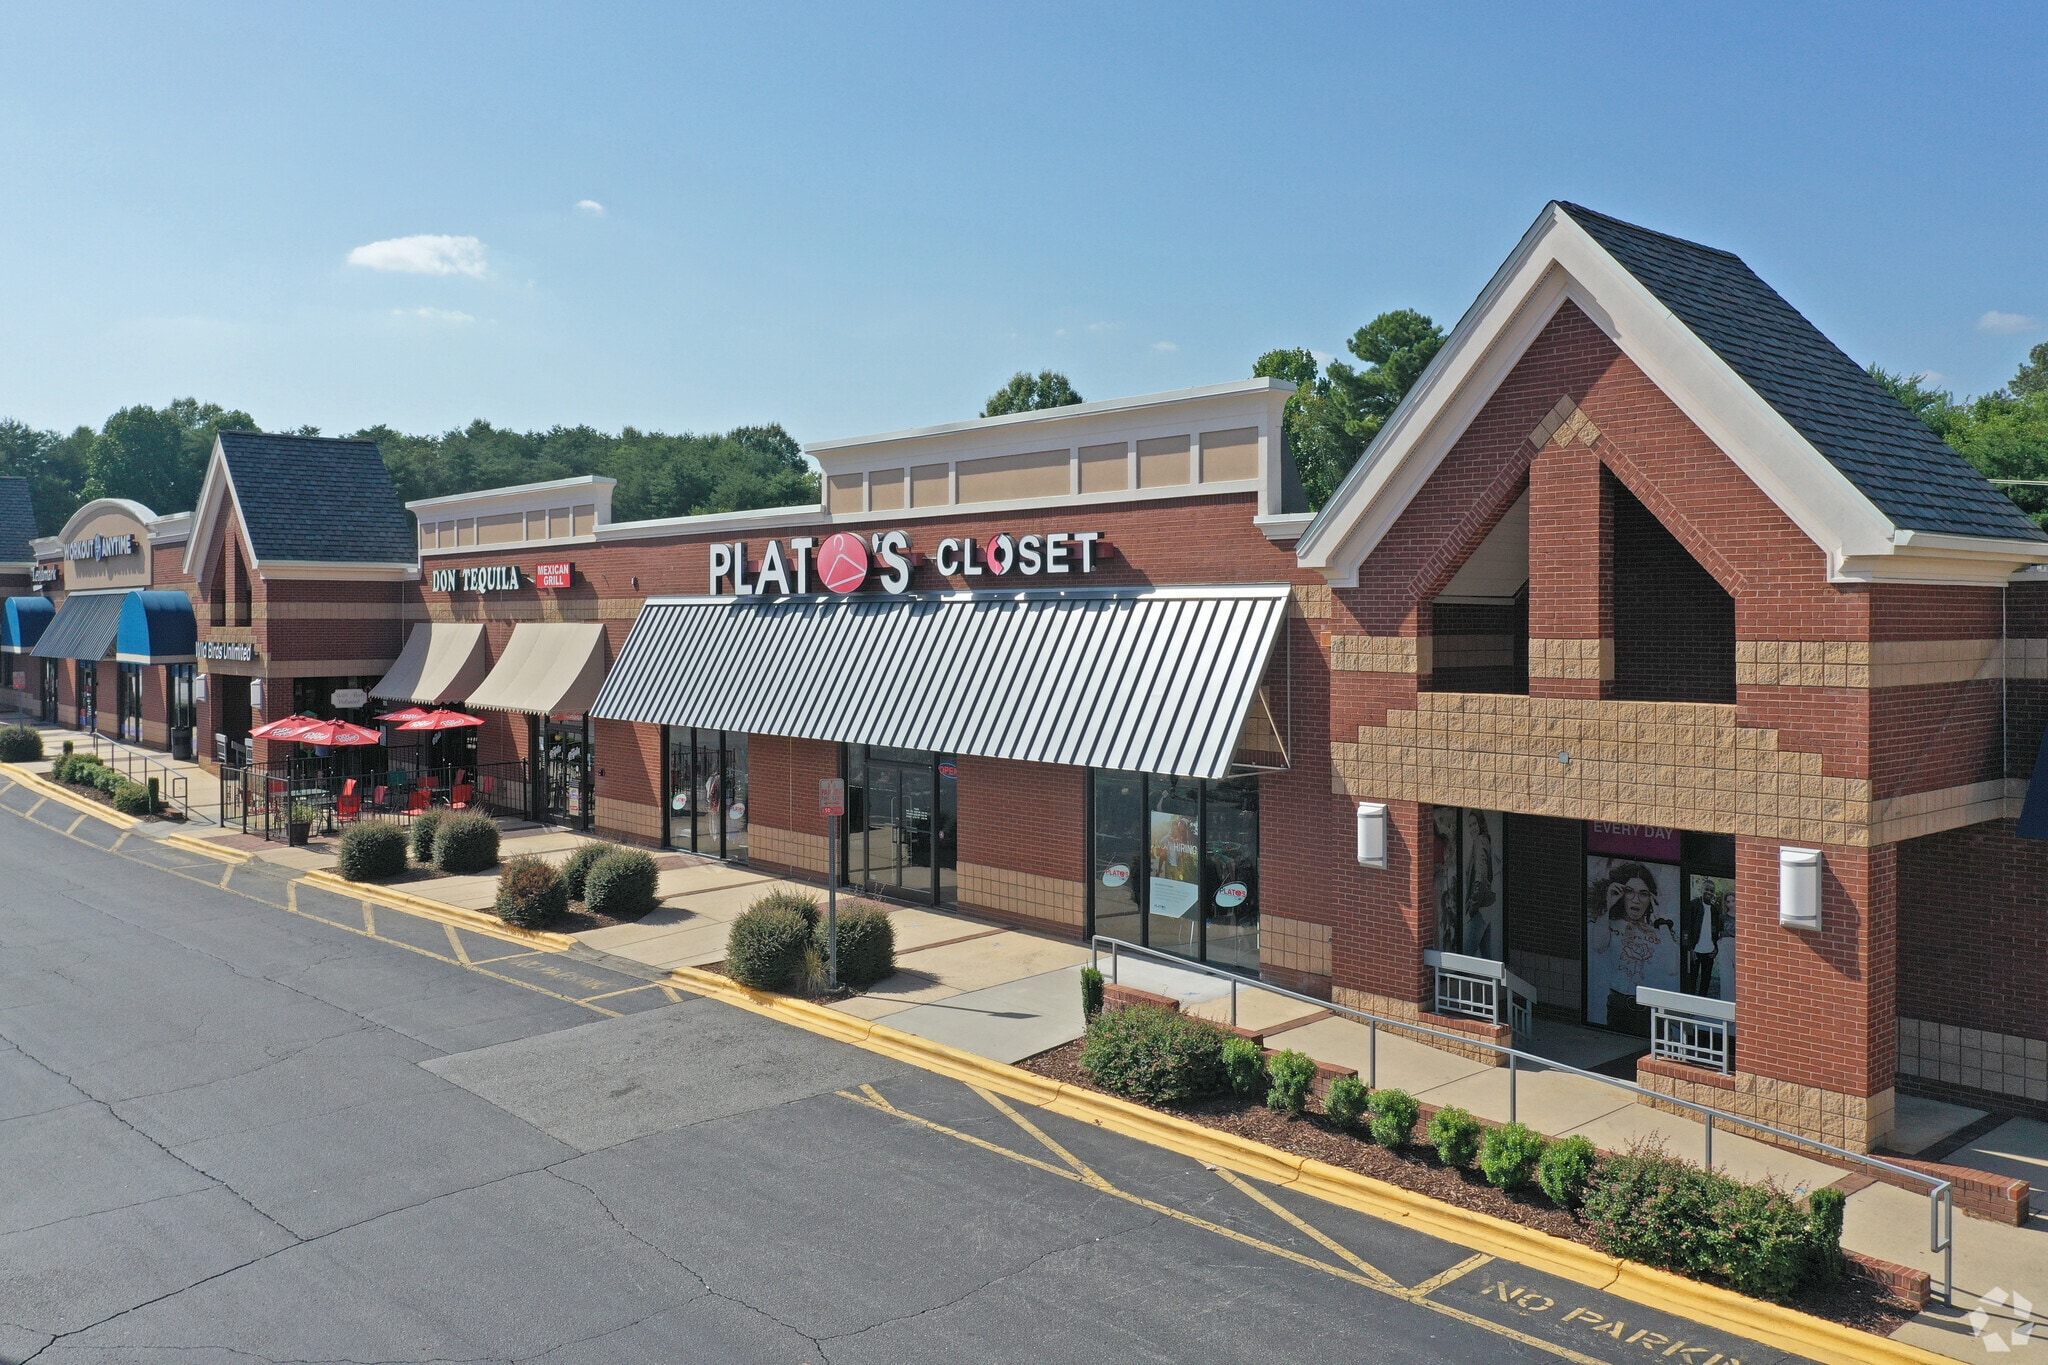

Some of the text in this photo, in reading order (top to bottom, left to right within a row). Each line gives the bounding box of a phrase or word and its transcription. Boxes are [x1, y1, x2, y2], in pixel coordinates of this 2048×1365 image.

[64, 534, 132, 561] WORKOUT ANYTIME
[936, 532, 1099, 576] CLOSET
[432, 565, 520, 594] DON TEQUILA
[537, 564, 570, 576] MEXICAN
[543, 574, 564, 586] GRILL
[208, 641, 222, 660] Birds
[223, 641, 251, 661] Unlimited
[1593, 821, 1674, 840] EVERY DAY
[1481, 1281, 1555, 1312] NO
